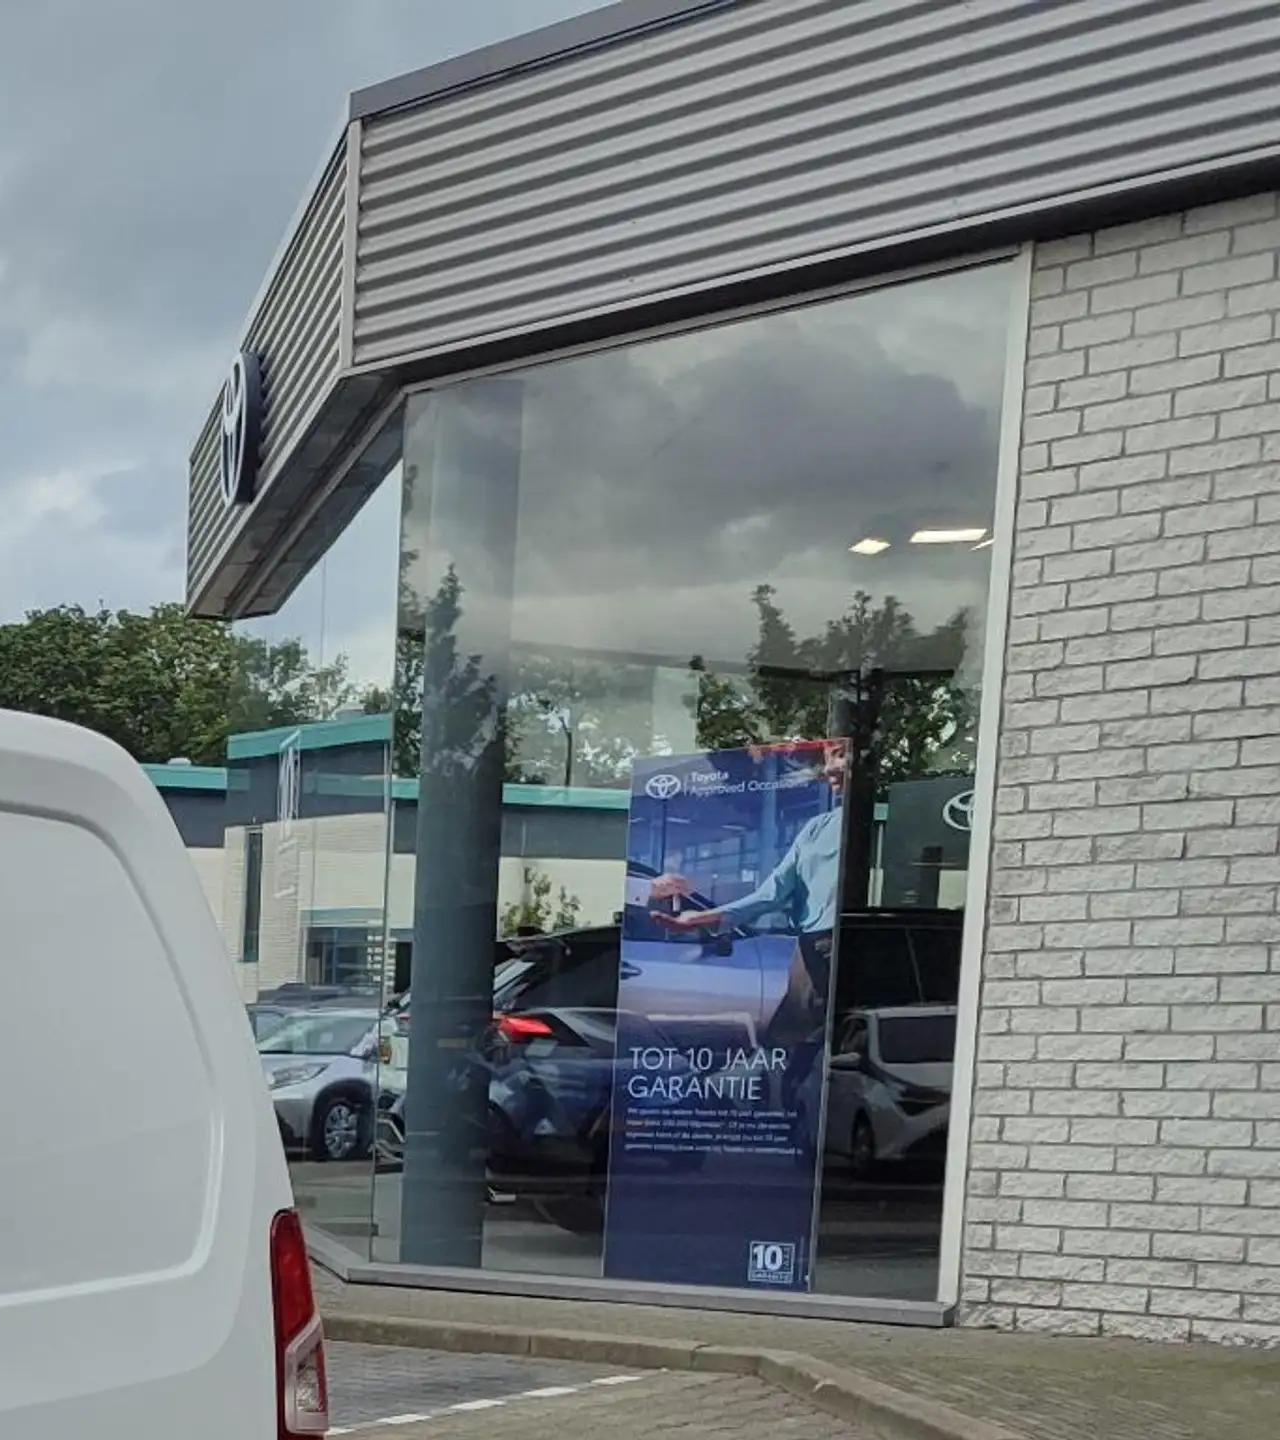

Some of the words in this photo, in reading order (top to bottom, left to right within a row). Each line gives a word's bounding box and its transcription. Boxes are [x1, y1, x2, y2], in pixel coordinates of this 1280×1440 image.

[691, 781, 745, 797] Approved
[692, 771, 730, 783] Toyota
[628, 1047, 678, 1071] TOT
[686, 1047, 713, 1071] 10
[719, 1047, 787, 1072] JAAR
[627, 1075, 763, 1101] GARANTIE
[753, 1244, 783, 1271] 10
